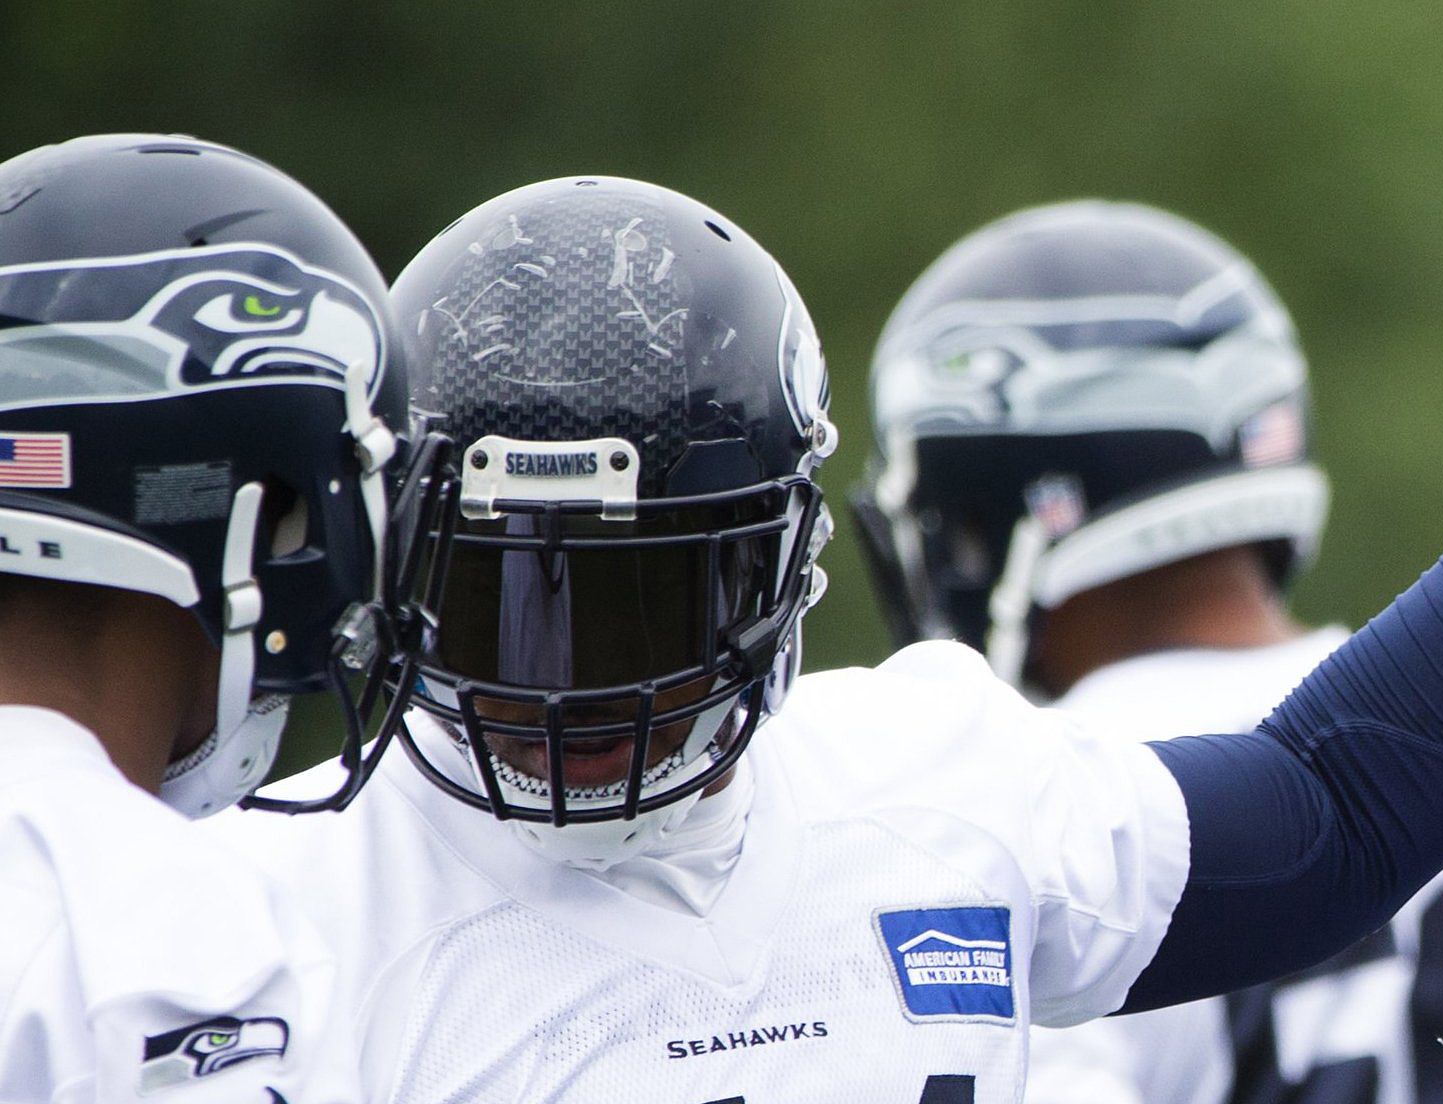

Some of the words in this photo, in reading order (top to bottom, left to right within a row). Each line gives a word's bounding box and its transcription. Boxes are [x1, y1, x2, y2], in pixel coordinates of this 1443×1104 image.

[505, 452, 598, 476] SEAHAWKS
[903, 950, 971, 969] AMERICAN
[666, 1021, 828, 1060] SEAHAWKS
